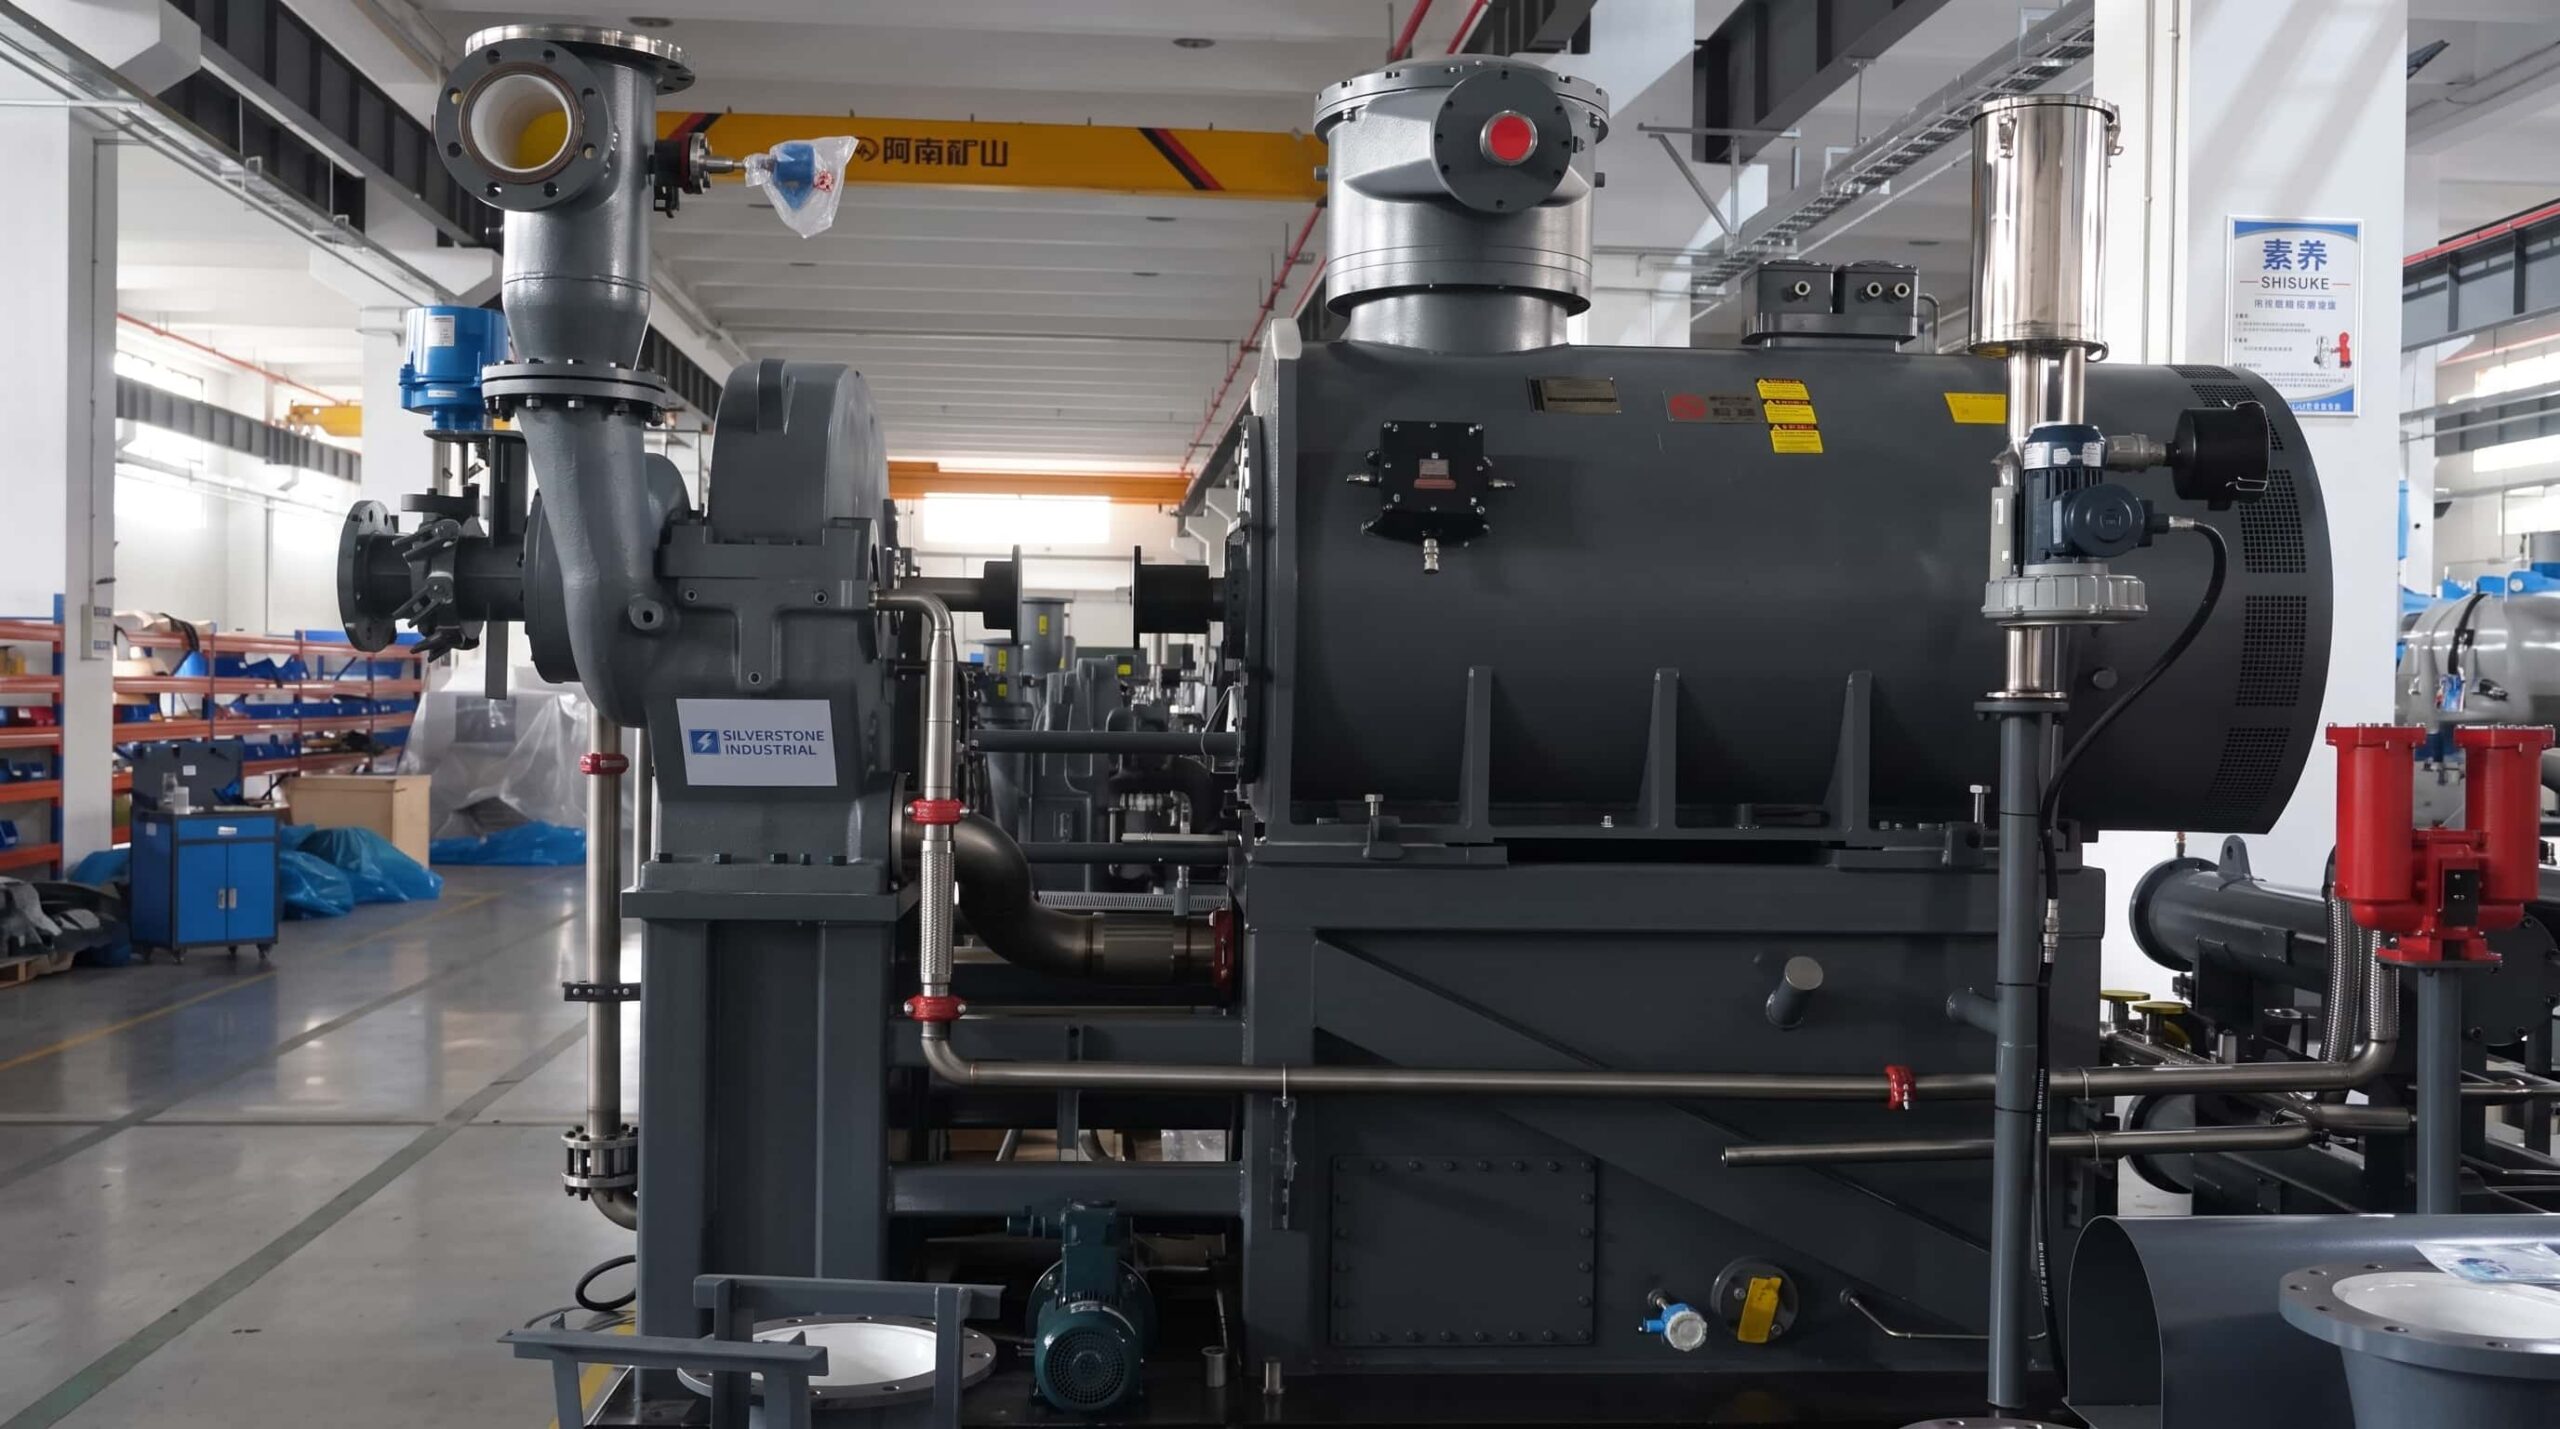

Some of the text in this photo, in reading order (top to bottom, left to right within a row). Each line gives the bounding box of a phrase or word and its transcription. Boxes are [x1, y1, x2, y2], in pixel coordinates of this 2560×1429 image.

[883, 136, 1008, 167] 阿南矿山
[2262, 238, 2328, 271] 素养
[2261, 275, 2330, 290] SHISUKE
[723, 729, 825, 742] SILVERSTONE
[725, 744, 817, 756] INDUSTRIAL
